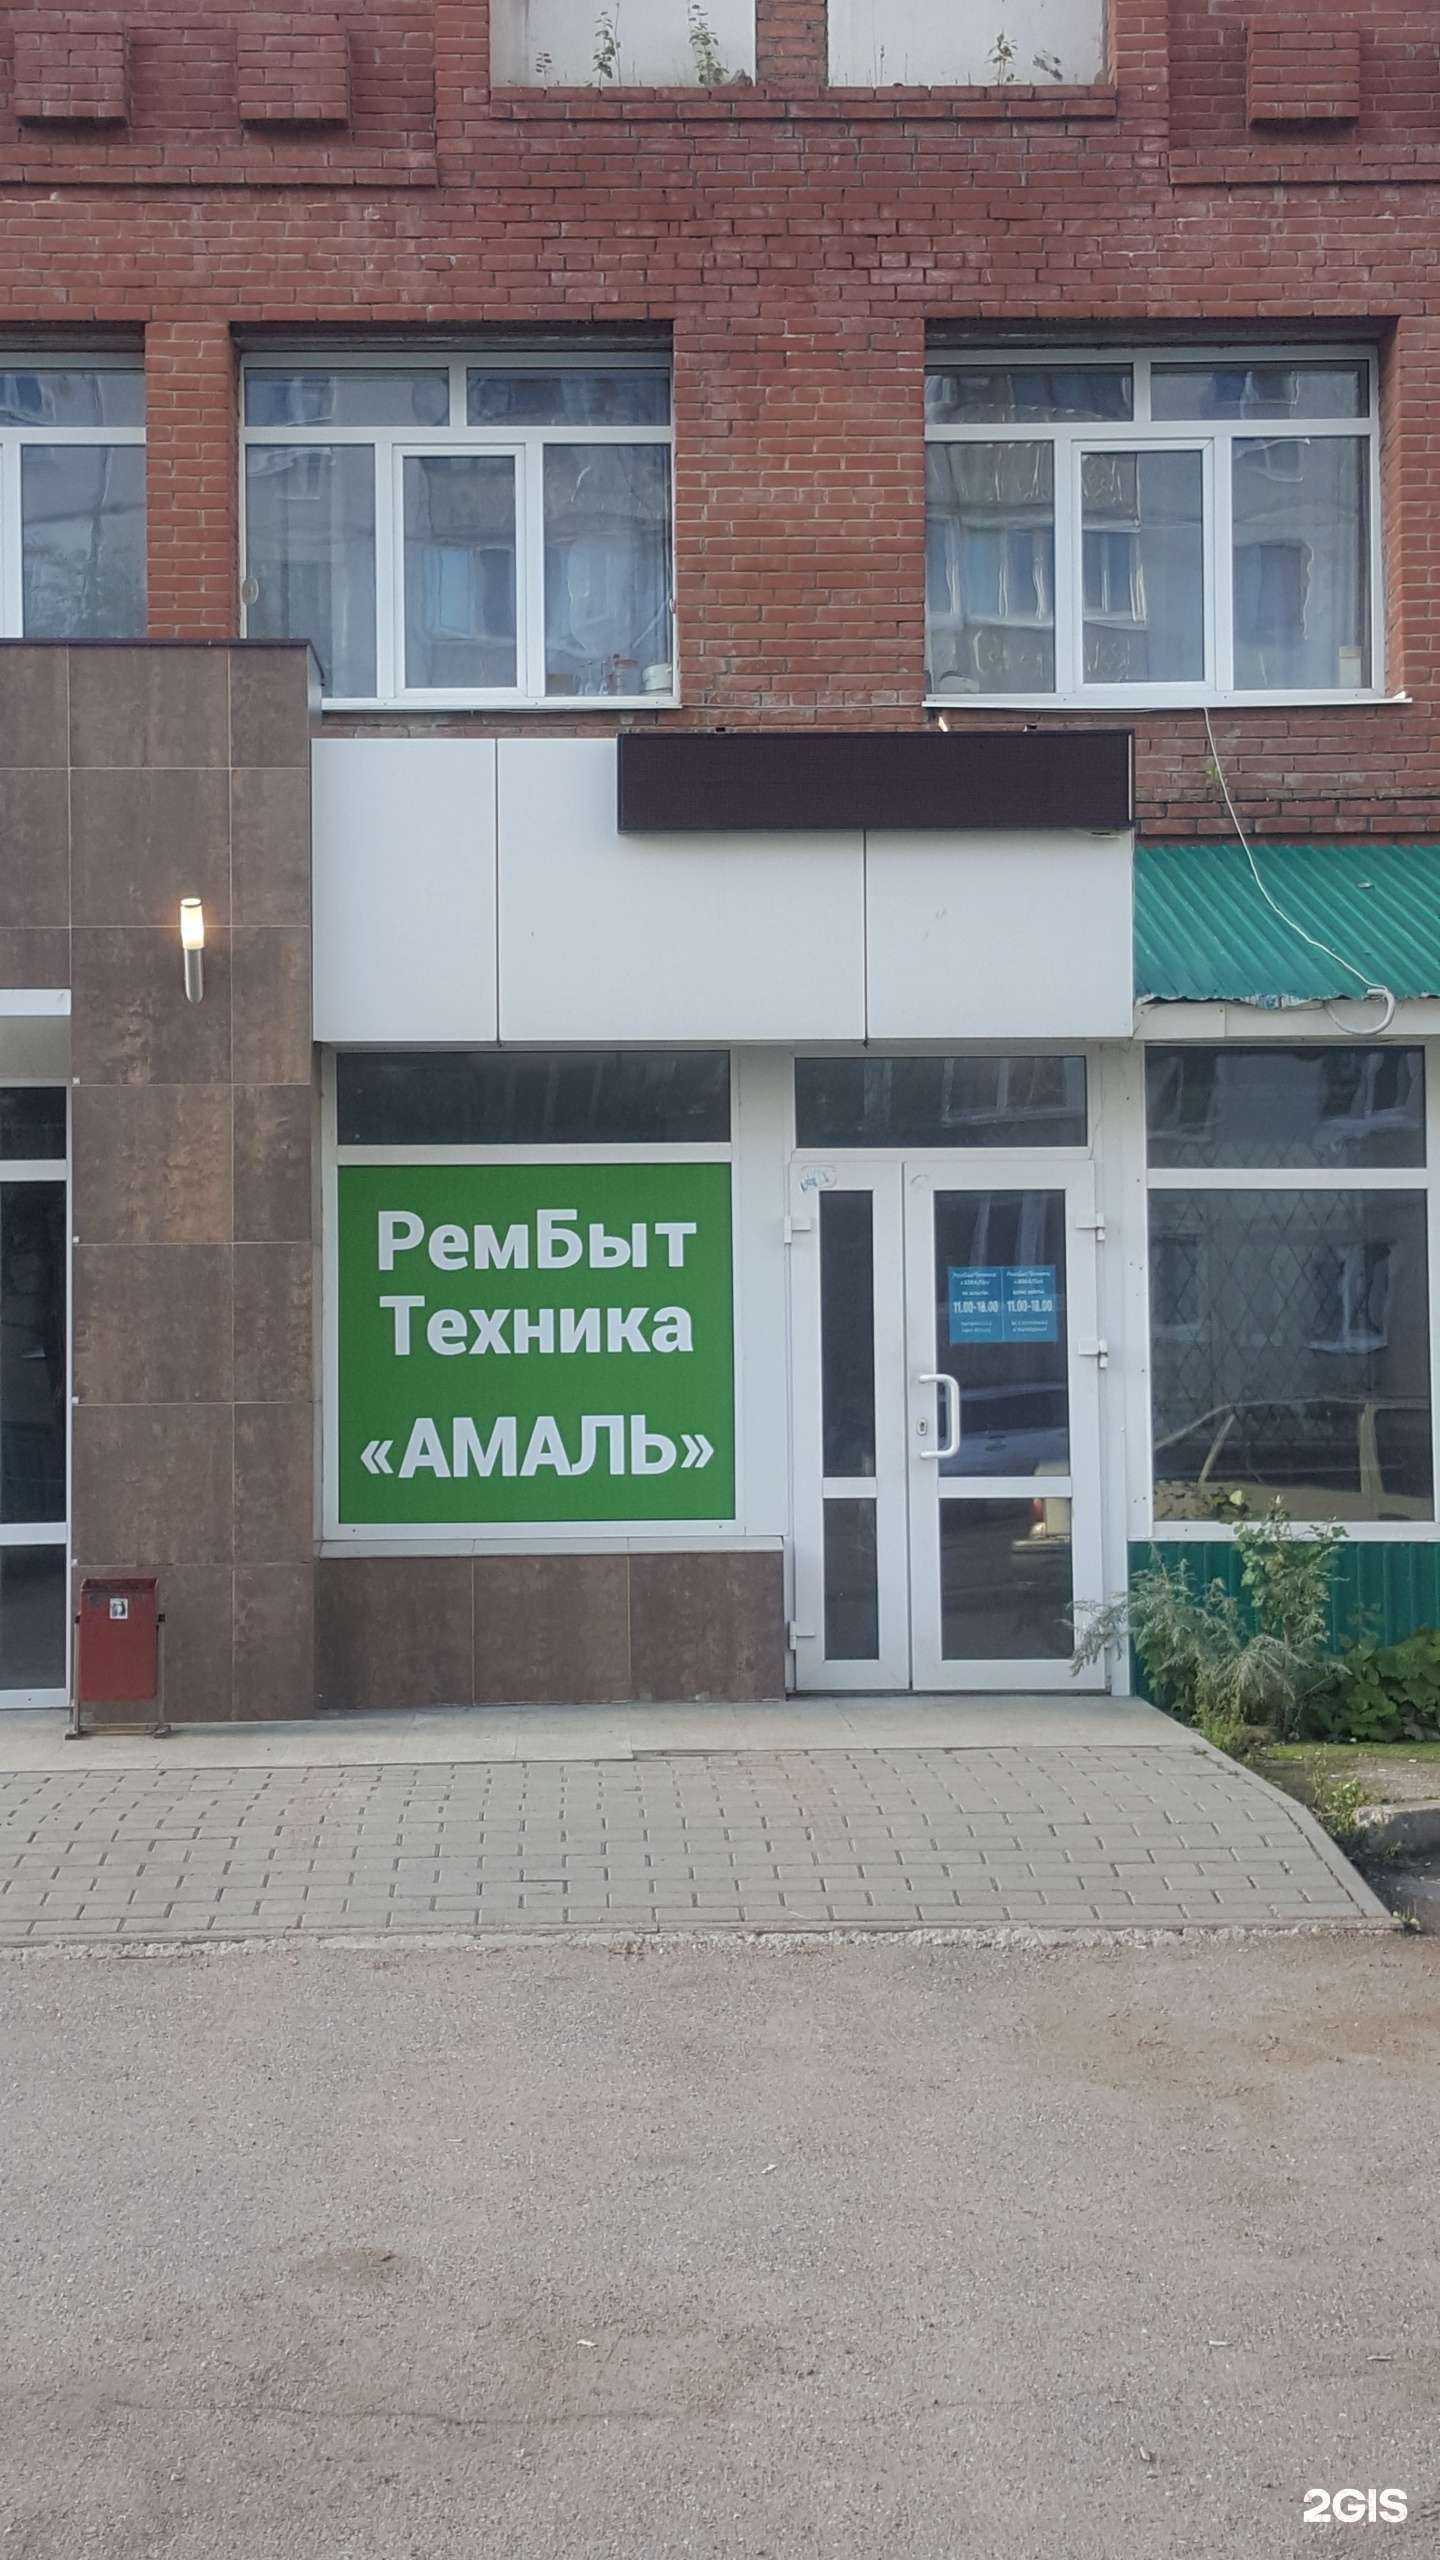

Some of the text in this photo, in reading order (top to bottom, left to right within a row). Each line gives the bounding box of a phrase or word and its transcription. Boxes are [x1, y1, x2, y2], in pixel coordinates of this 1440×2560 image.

[377, 1208, 698, 1271] РемБыт
[379, 1295, 694, 1356] Техника
[360, 1414, 715, 1478] «АМАЛЬ»
